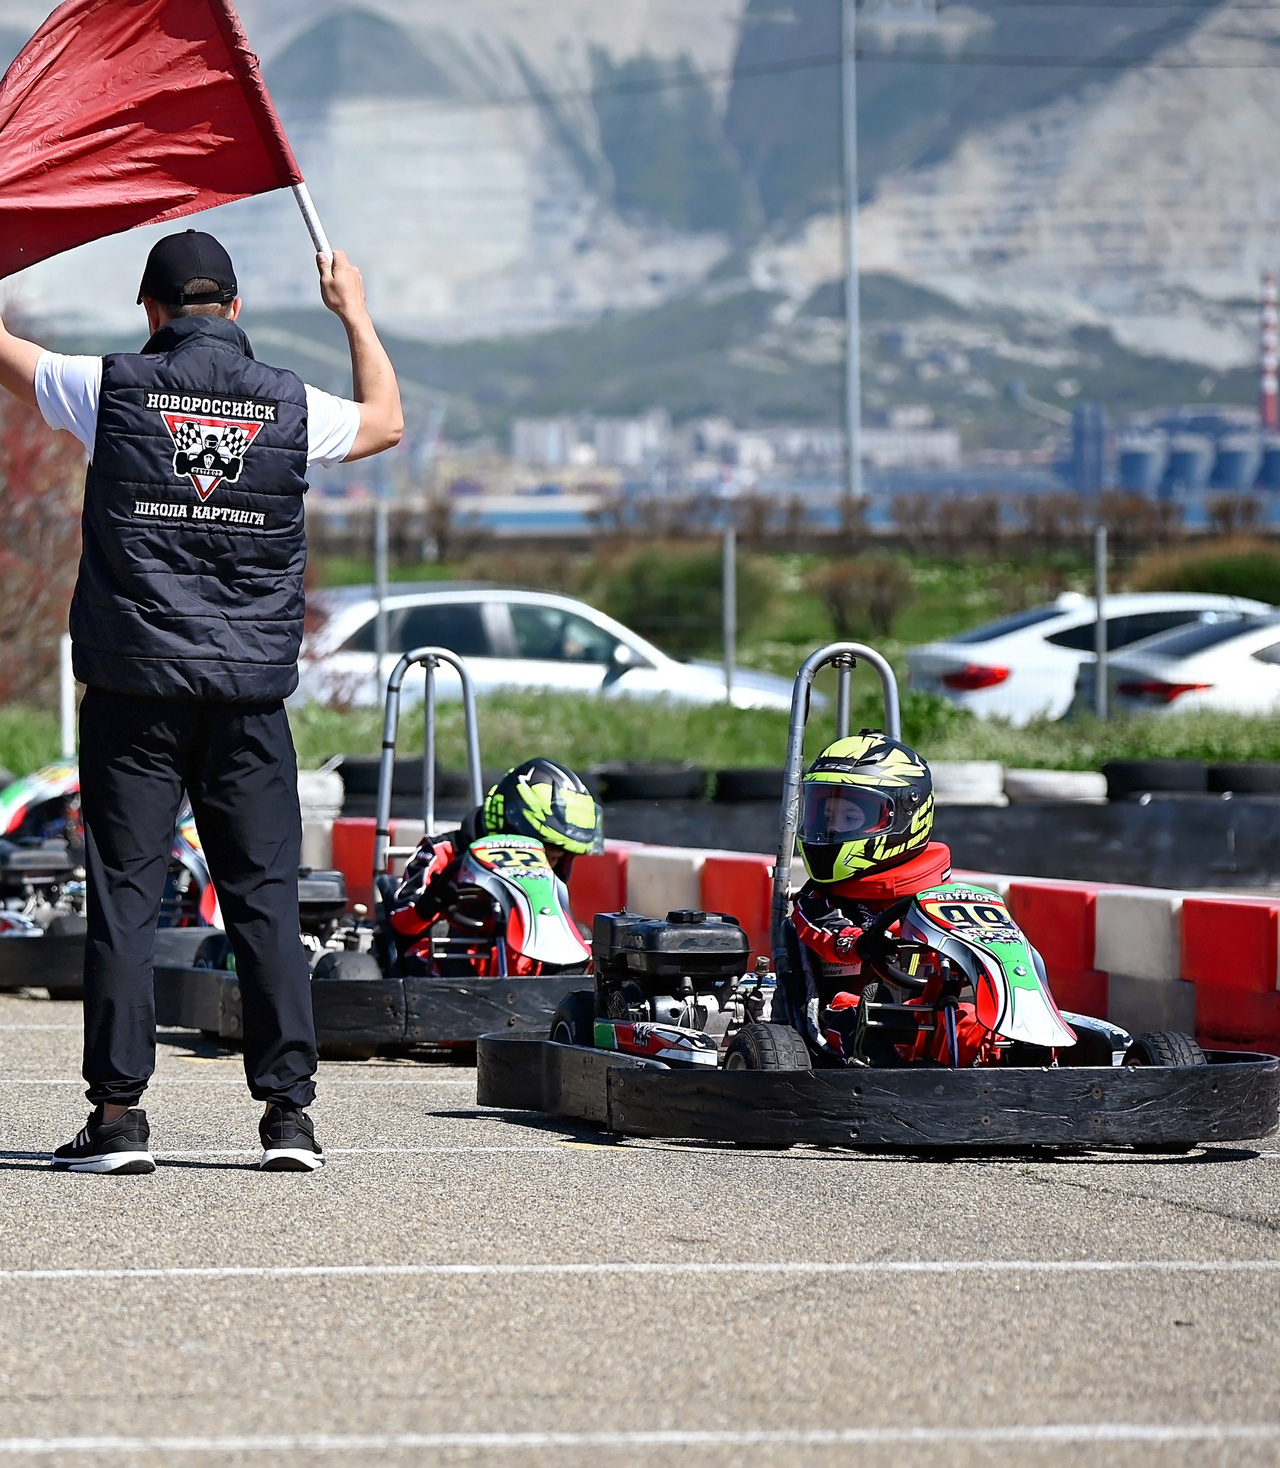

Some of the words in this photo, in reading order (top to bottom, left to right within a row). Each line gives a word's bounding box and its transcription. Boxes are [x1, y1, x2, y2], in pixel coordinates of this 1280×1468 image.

[146, 393, 275, 421] НОВОРОССИЙСК
[134, 501, 187, 518] ШКОЛА
[192, 506, 265, 526] КАРТИНГА
[488, 850, 543, 868] 22
